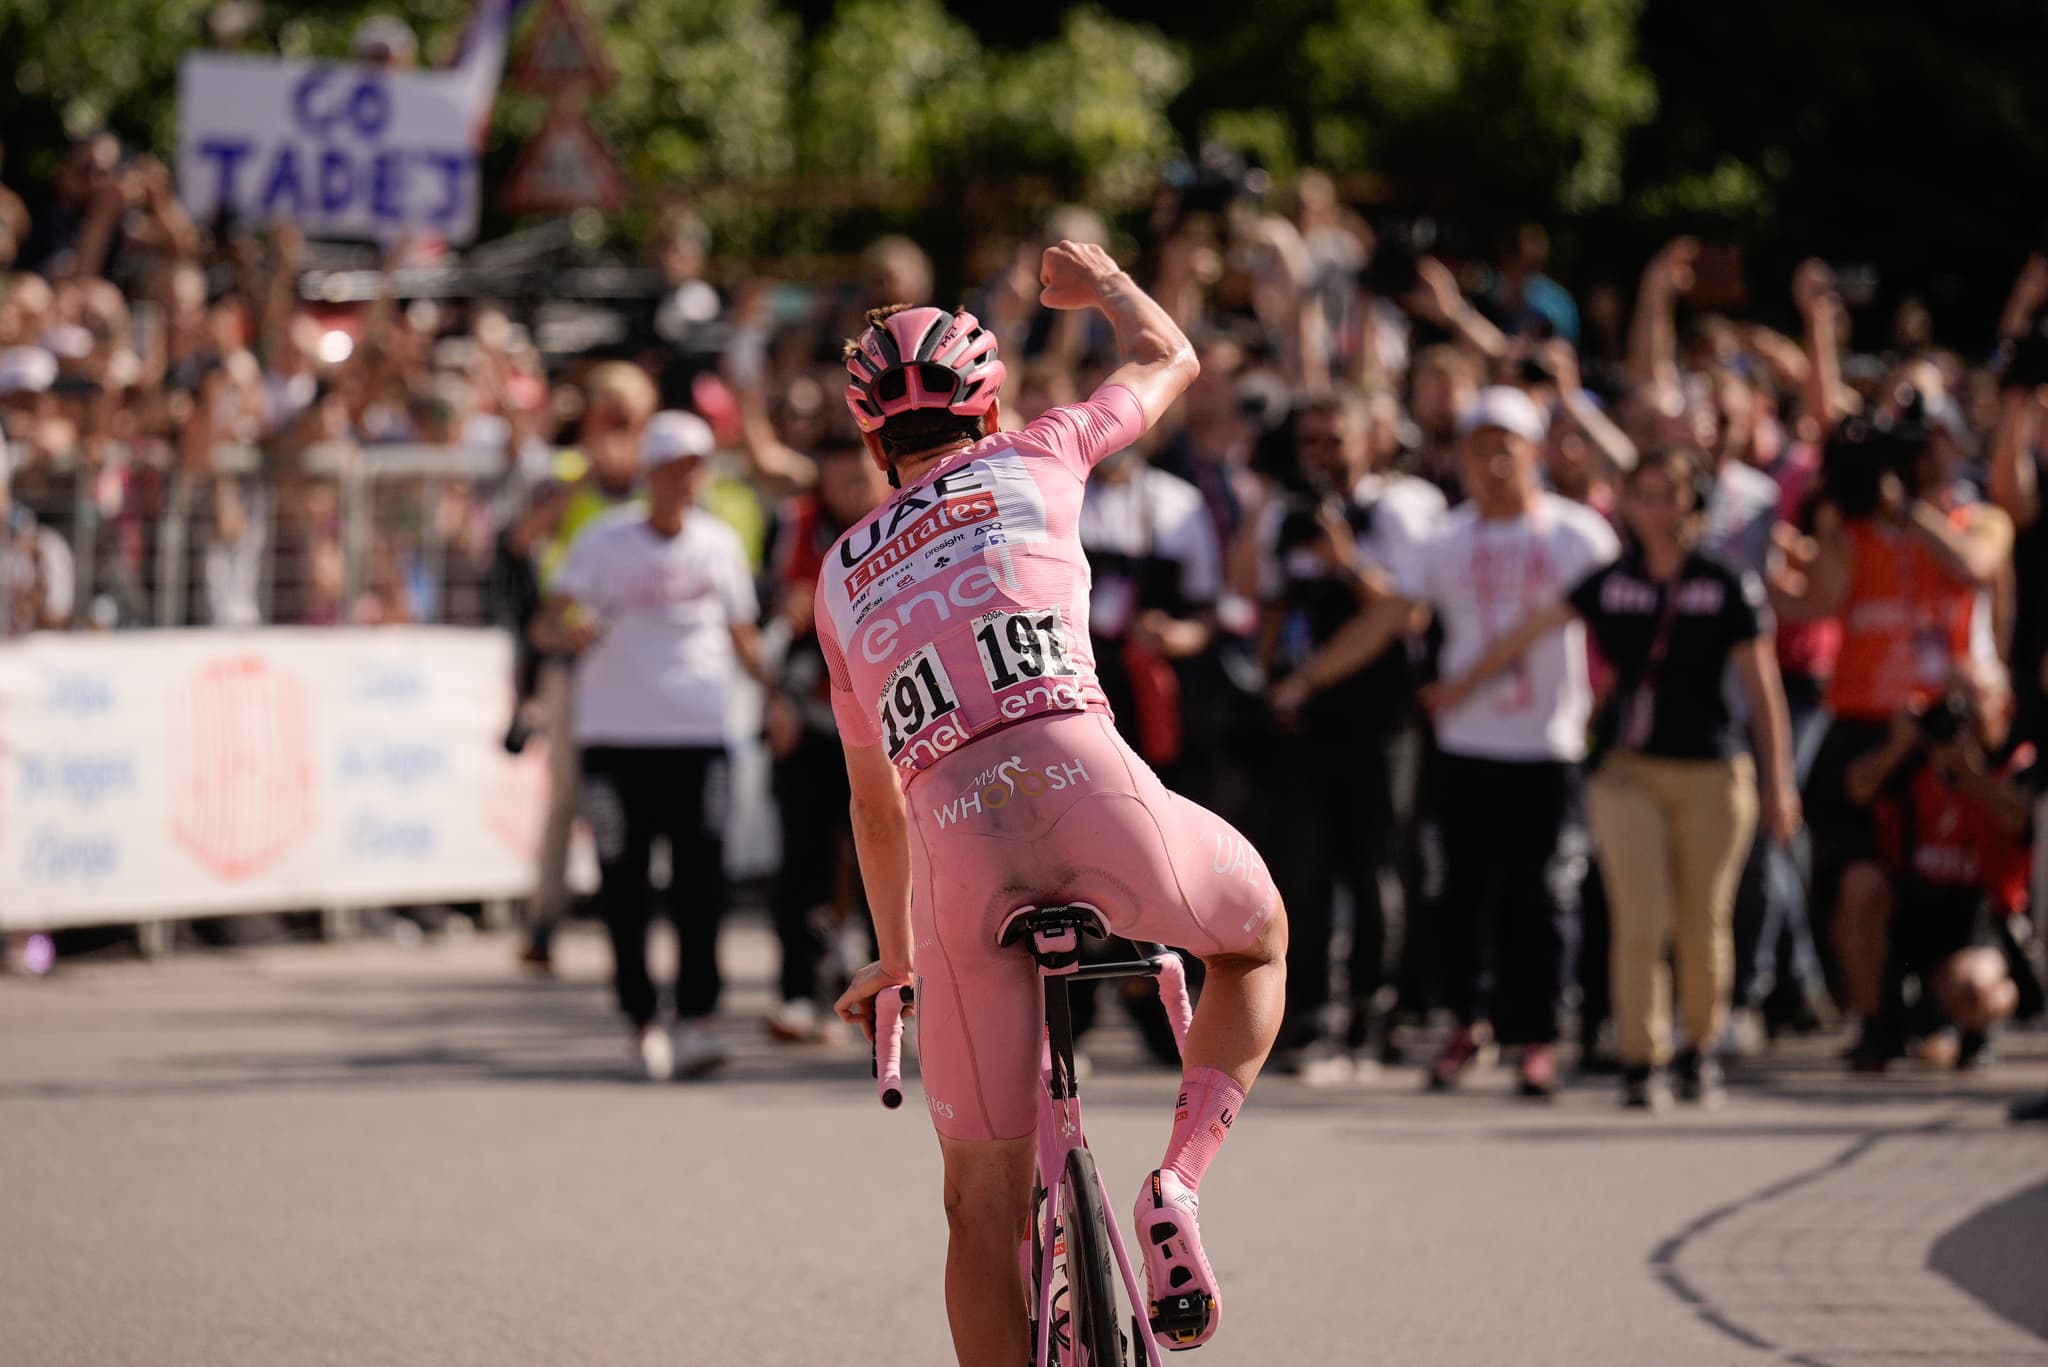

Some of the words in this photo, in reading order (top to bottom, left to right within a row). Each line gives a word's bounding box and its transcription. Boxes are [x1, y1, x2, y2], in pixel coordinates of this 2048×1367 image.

[196, 138, 470, 222] TADEJ
[841, 463, 982, 568] UAE
[849, 499, 993, 596] Emirates
[924, 533, 966, 559] presight
[862, 545, 1024, 664] enel
[977, 614, 1077, 691] 191
[882, 656, 956, 761] 191
[1000, 676, 1088, 718] enel
[933, 758, 1090, 830] WHOOSH
